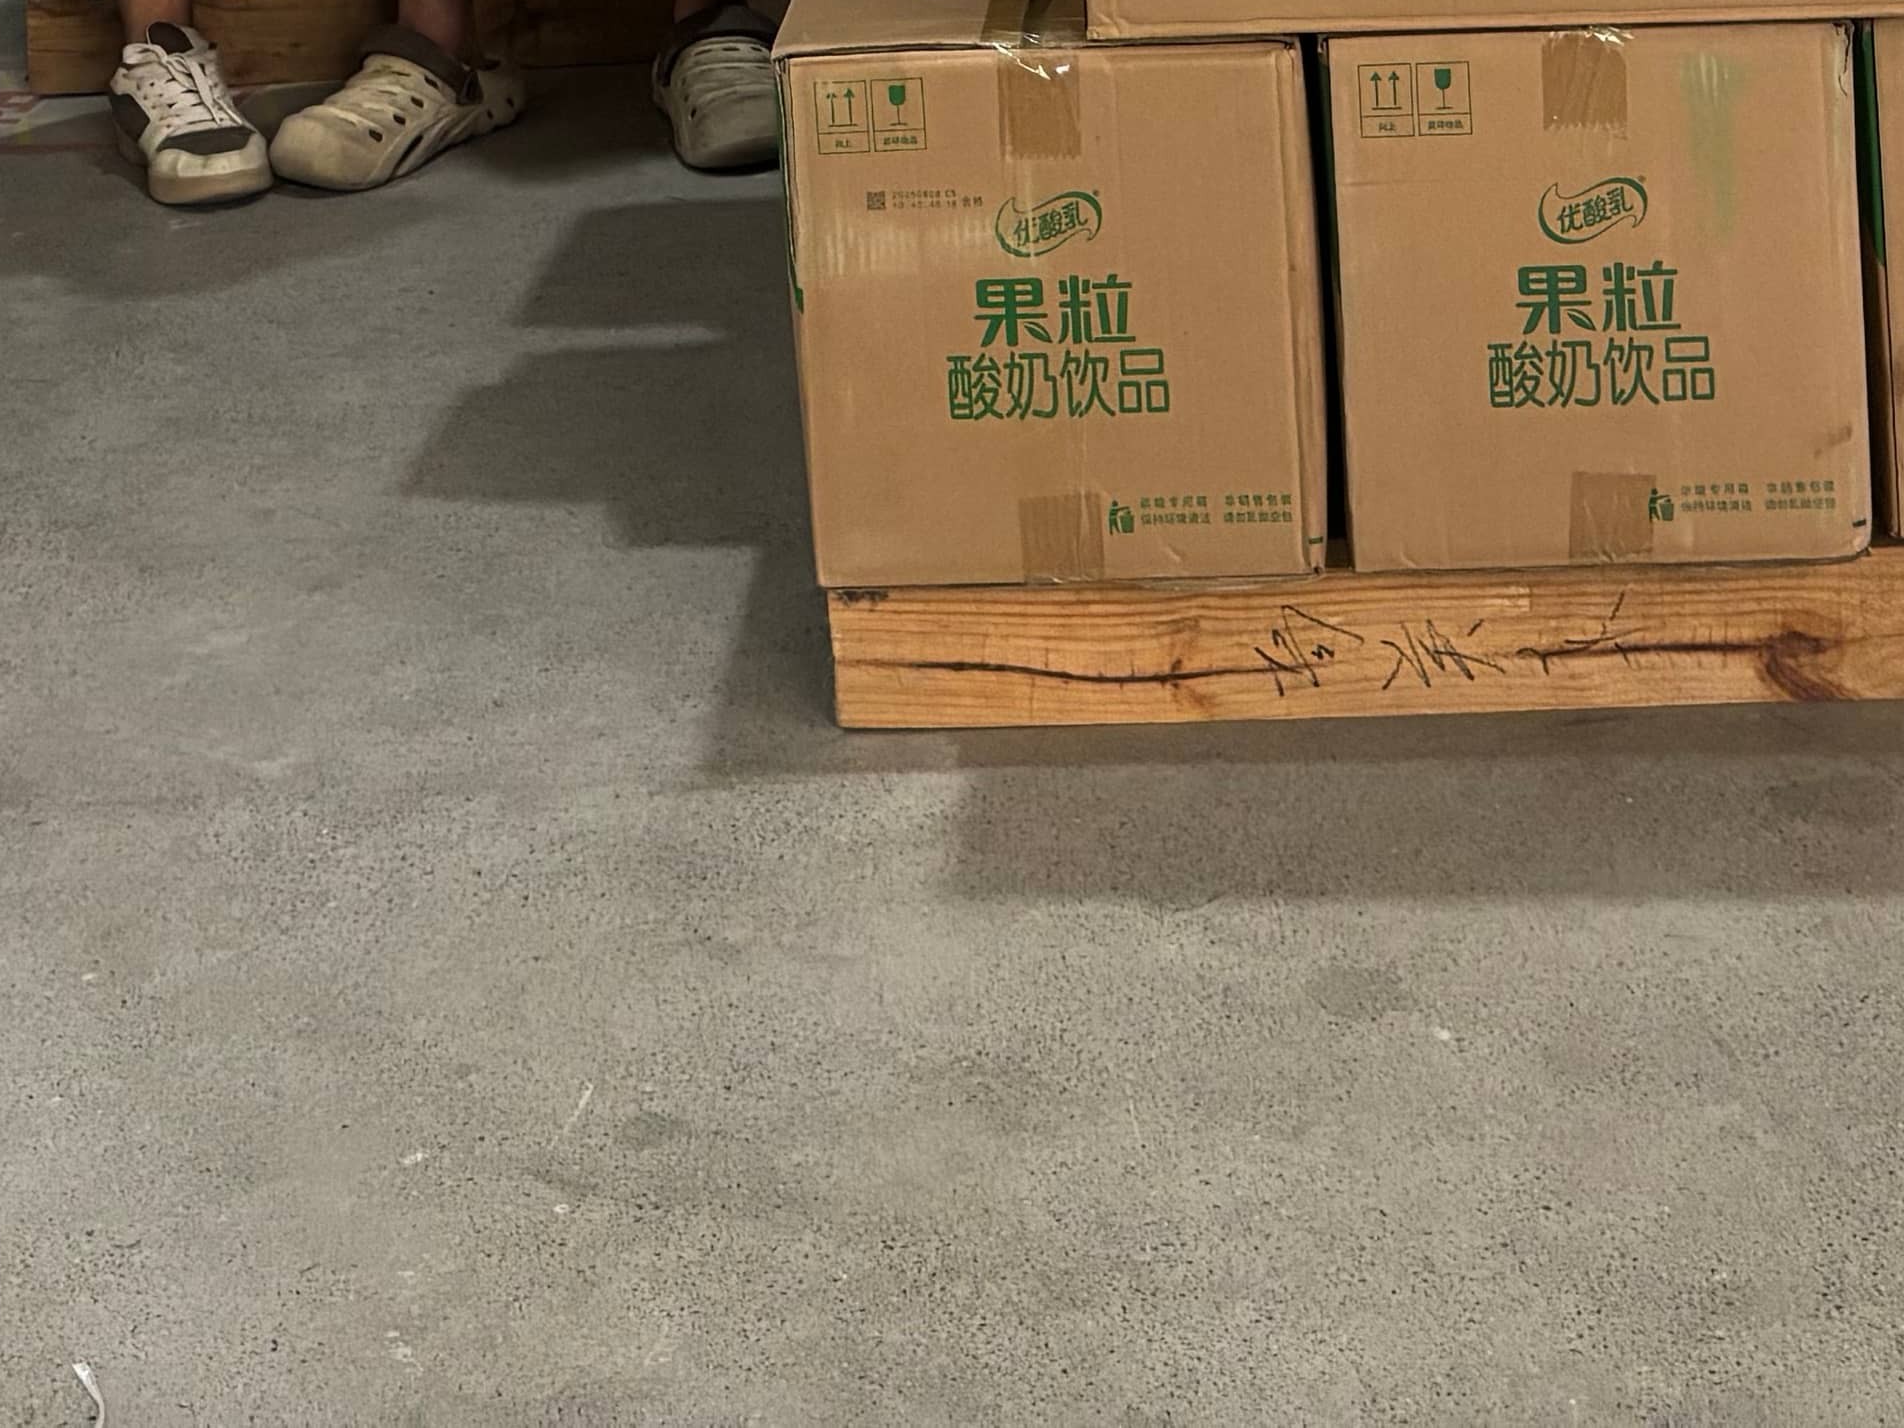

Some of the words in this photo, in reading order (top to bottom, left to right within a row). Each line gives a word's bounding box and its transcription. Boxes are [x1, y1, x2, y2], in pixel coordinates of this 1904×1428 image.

[1013, 201, 1087, 247] 优酸乳
[1557, 185, 1634, 236] 优酸乳
[973, 274, 1137, 347] 果粒
[1516, 261, 1681, 335] 果粒
[946, 348, 1170, 422] 酸奶饮品
[1488, 335, 1716, 409] 酸奶饮品
